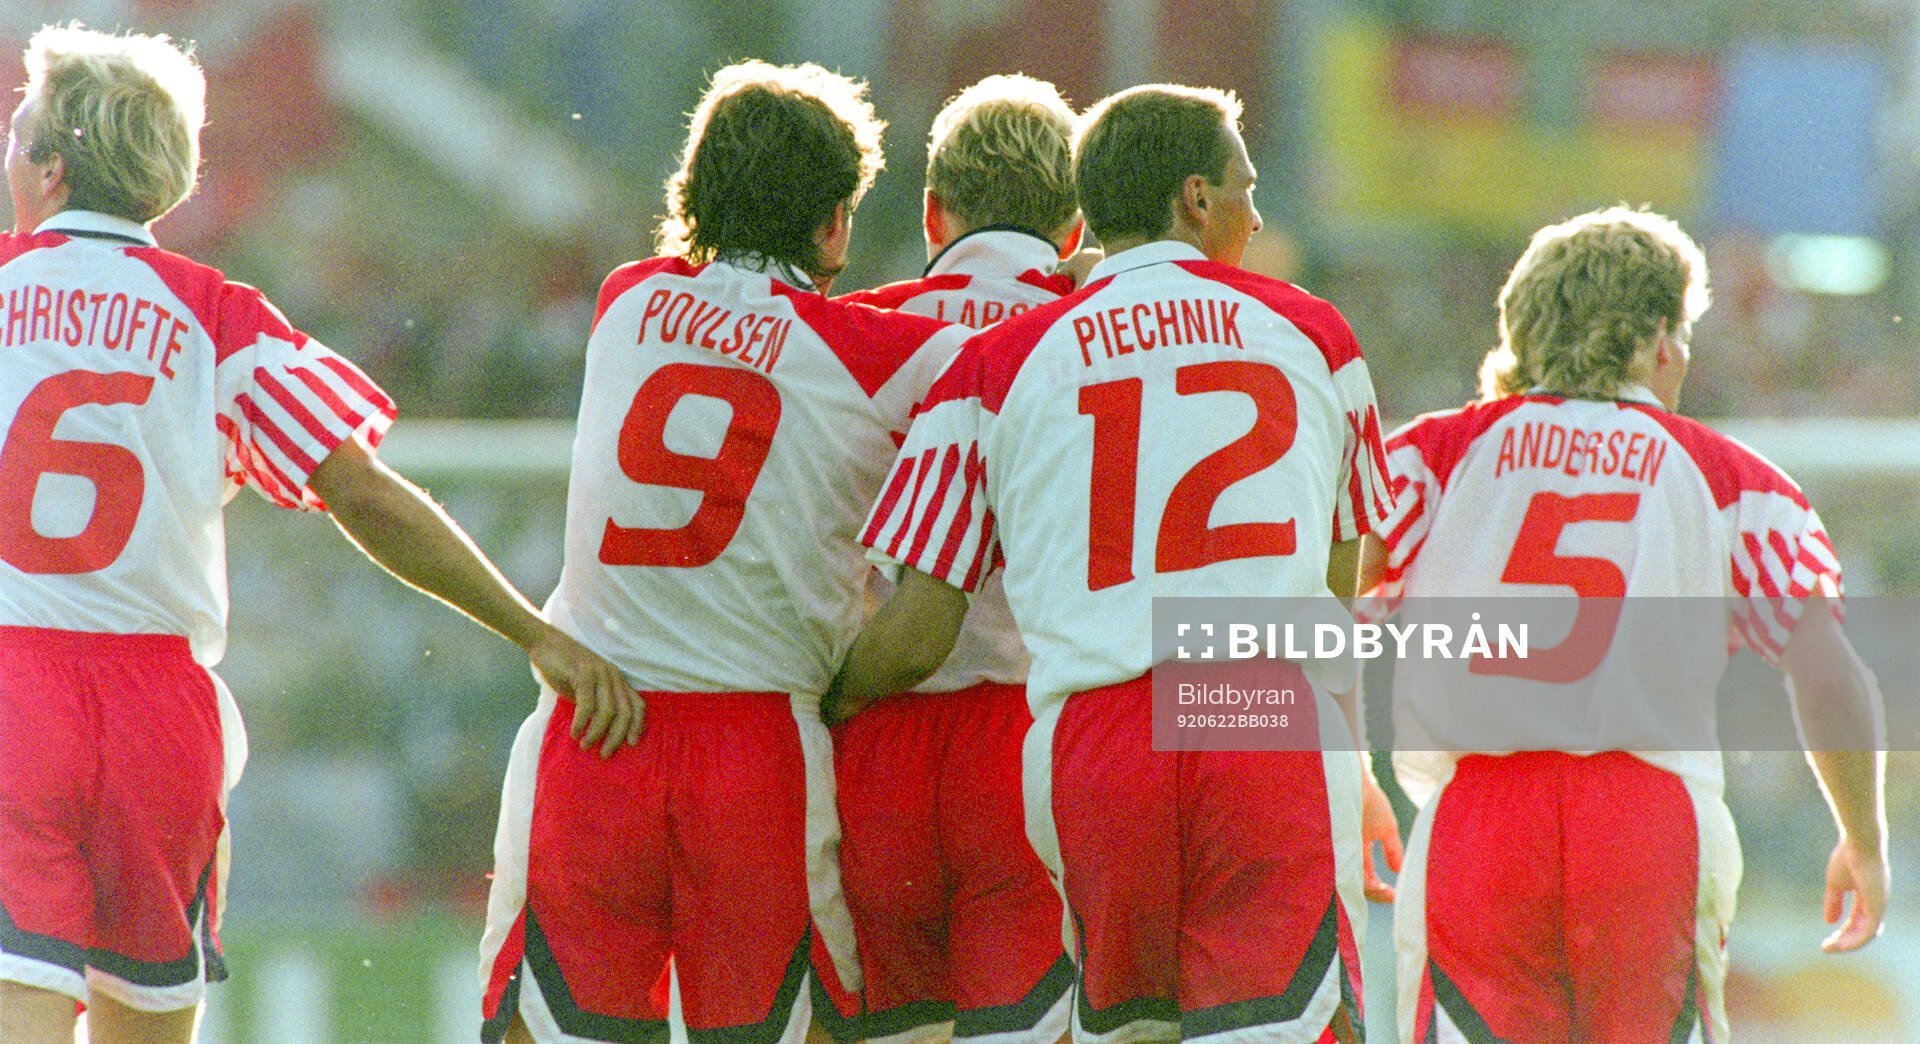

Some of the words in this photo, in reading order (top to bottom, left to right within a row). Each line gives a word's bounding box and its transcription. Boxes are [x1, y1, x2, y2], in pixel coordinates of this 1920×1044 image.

[0, 285, 189, 380] HRISTOFTE
[637, 289, 792, 374] POVLSEN
[1073, 299, 1244, 367] PIECHNIK
[0, 369, 155, 574] 6
[598, 362, 782, 568] 9
[1078, 360, 1298, 592] 12
[1495, 421, 1667, 487] ANDERSEN
[1468, 492, 1641, 684] 5
